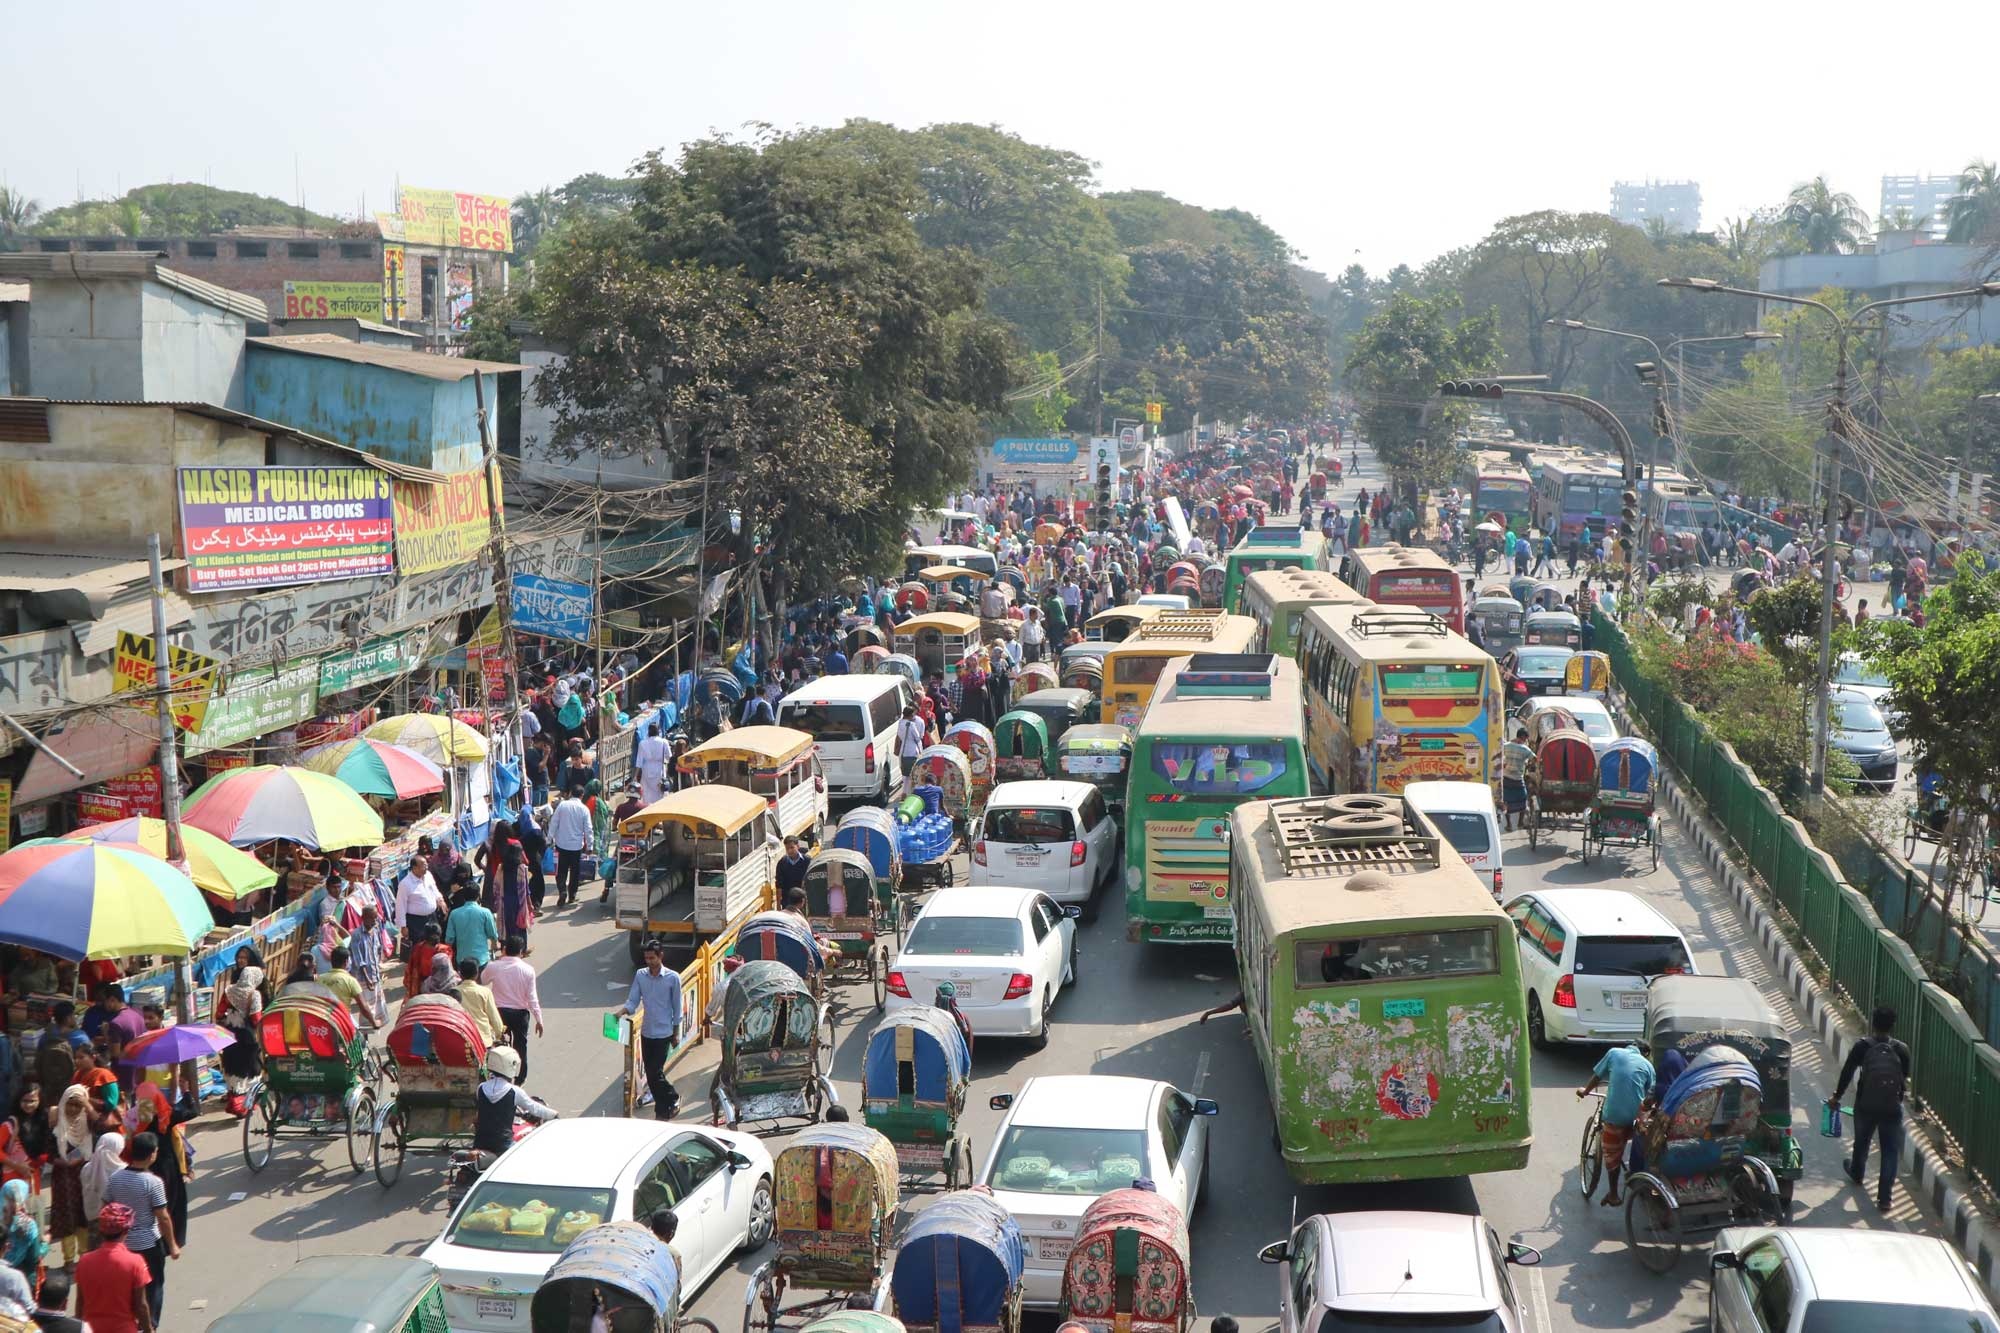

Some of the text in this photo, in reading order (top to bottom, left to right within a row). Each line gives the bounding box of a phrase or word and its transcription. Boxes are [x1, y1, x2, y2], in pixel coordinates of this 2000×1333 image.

[460, 226, 505, 250] BCS
[286, 295, 329, 318] BCS
[1035, 442, 1070, 452] CABLES
[183, 468, 389, 504] NASIB PUBLICATION'S
[225, 502, 364, 524] MEDICAL BOOKS
[394, 468, 503, 535] SONIA MEDICL
[246, 552, 279, 563] Medical
[399, 537, 425, 569] BOOK
[197, 569, 216, 580] Buy
[218, 567, 237, 578] One
[256, 564, 280, 575] Book
